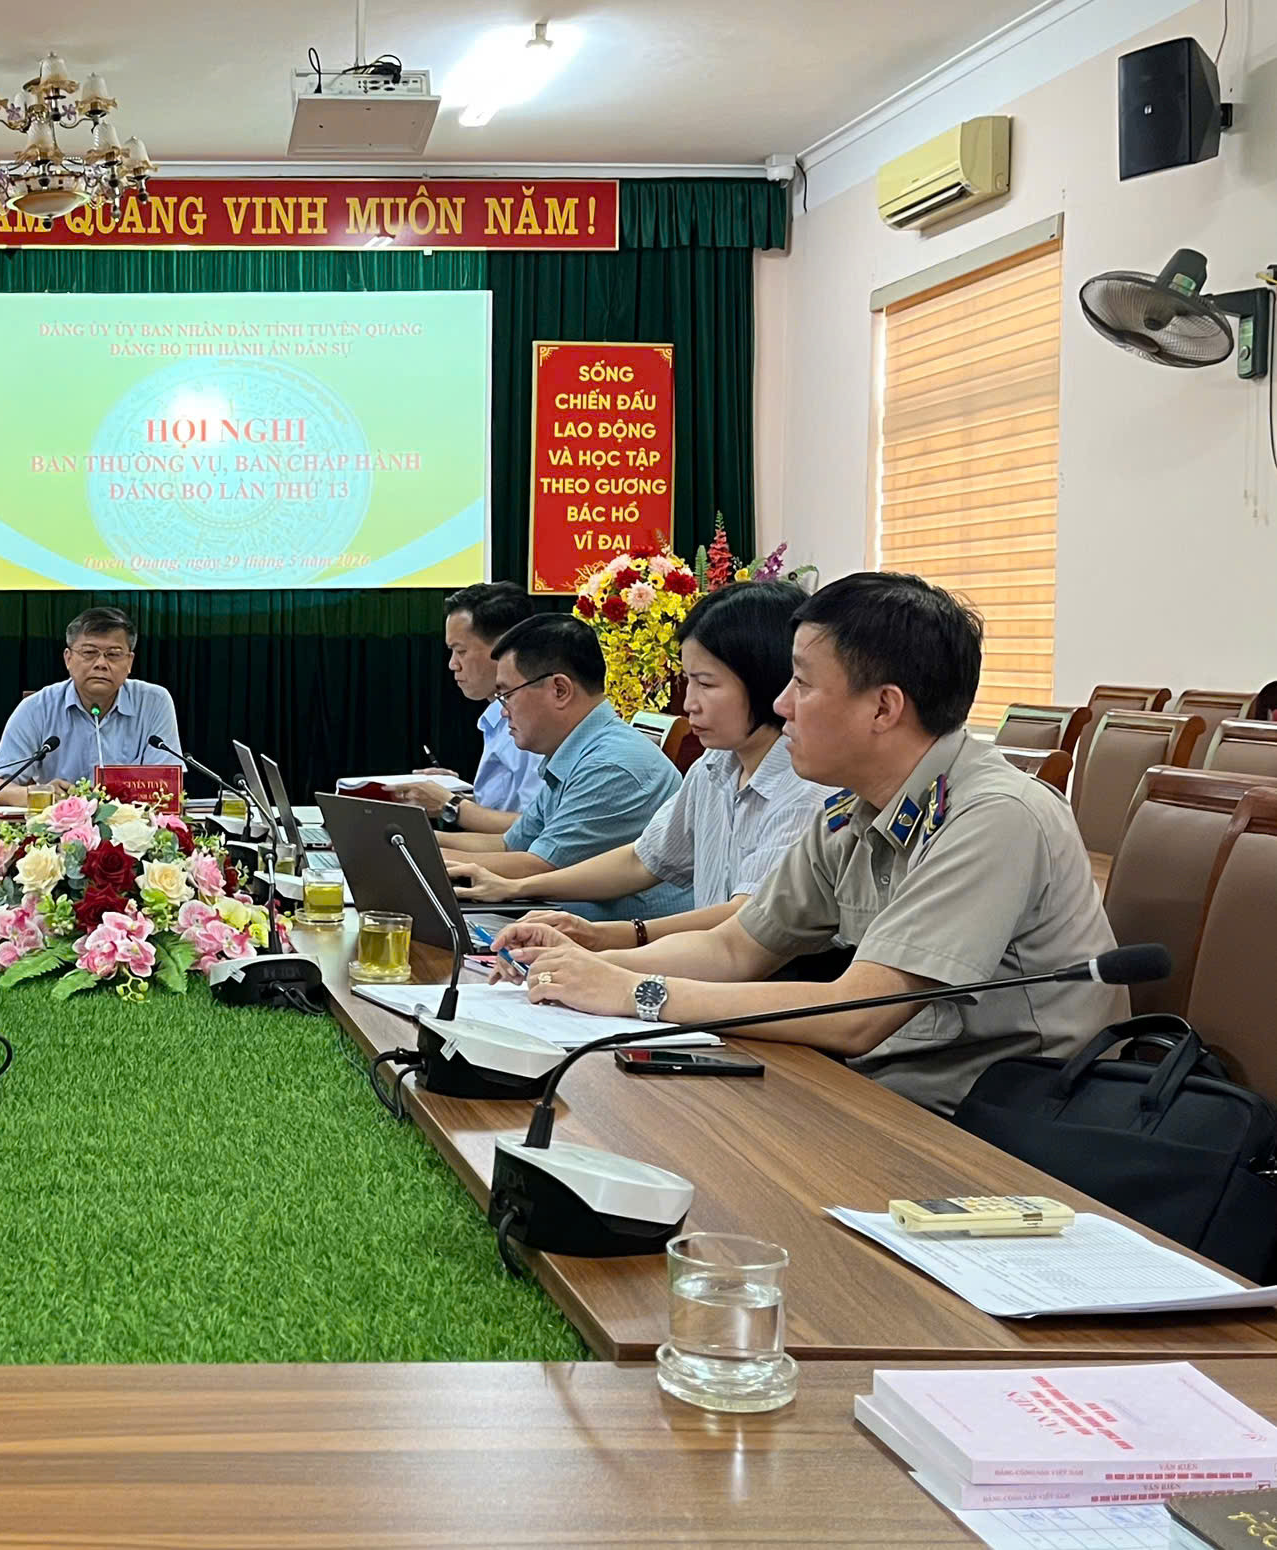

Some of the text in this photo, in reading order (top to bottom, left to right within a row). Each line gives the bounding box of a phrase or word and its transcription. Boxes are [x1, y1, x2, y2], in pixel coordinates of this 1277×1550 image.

[64, 196, 208, 237] QUANG
[223, 196, 328, 236] VINH
[345, 184, 466, 236] MUÔN
[38, 320, 423, 339] ĐẢNG ỦY ỦY BAN NHÂN DÂN TỈNH TUYÊN QUANG
[109, 339, 354, 359] ĐẢNG BỘ THI HÀNH ÁN DÂN SỰ
[579, 360, 634, 383] SỐNG
[555, 388, 656, 411] CHIẾN ĐẤU
[220, 418, 308, 448] NGHỊ
[554, 418, 657, 443] LAO ĐỘNG
[30, 455, 77, 473] BAN
[83, 450, 185, 473] THƯỜNG
[235, 455, 283, 472] BAN
[286, 451, 350, 472] CHẤP
[355, 449, 421, 472] HÀNH
[548, 445, 661, 471] VÀ HỌC TẬP
[109, 478, 349, 504] ĐẢNG BỘ LẦN THỨ 13
[540, 478, 667, 495] THEO GƯƠNG
[567, 501, 640, 523] BÁC HỒ
[574, 530, 631, 555] VĨ ĐẠI
